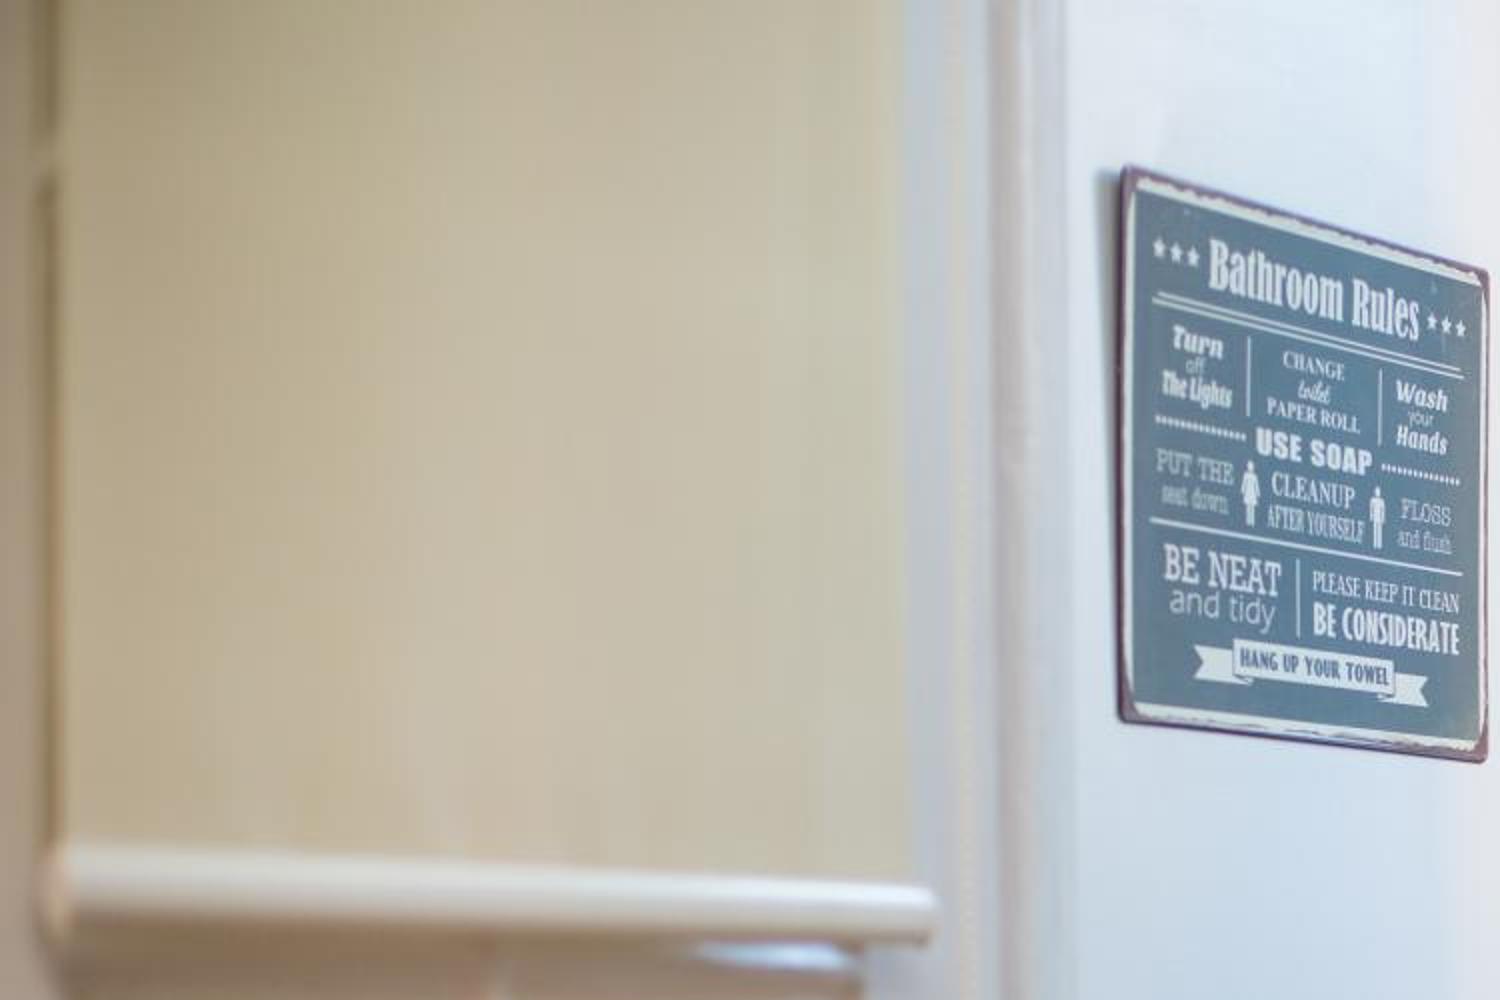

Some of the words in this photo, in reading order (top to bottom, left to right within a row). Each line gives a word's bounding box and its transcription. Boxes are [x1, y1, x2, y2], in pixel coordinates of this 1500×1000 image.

[1209, 238, 1344, 322] Bathroom
[1352, 277, 1420, 341] Rules
[1173, 324, 1223, 360] Turn
[1283, 350, 1345, 381] CHANGE
[1189, 376, 1232, 410] Lights
[1396, 380, 1448, 412] Wash
[1267, 396, 1316, 427] PAPER
[1321, 408, 1360, 434] ROLL
[1256, 427, 1302, 462] USE
[1311, 439, 1373, 476] SOAP
[1396, 425, 1448, 455] Hands
[1156, 448, 1192, 477] PUT
[1198, 457, 1235, 485] THE
[1268, 503, 1303, 537] AFTER
[1306, 511, 1365, 544] YOURSELF
[1400, 498, 1452, 527] FLOSS
[1164, 543, 1199, 585] BE
[1208, 551, 1281, 597] NEAT
[1313, 570, 1360, 598] PLEASE
[1365, 579, 1398, 603] KEEP
[1402, 585, 1416, 607] IT
[1419, 589, 1460, 614] CLEAN
[1169, 589, 1220, 619] and
[1229, 594, 1276, 635] tidy
[1313, 601, 1337, 638] BE
[1342, 607, 1460, 656] CONSIDERATE
[1240, 648, 1278, 672] HANG
[1283, 652, 1299, 673] UP
[1304, 656, 1340, 680] YOUR
[1345, 661, 1389, 686] TOWEL
